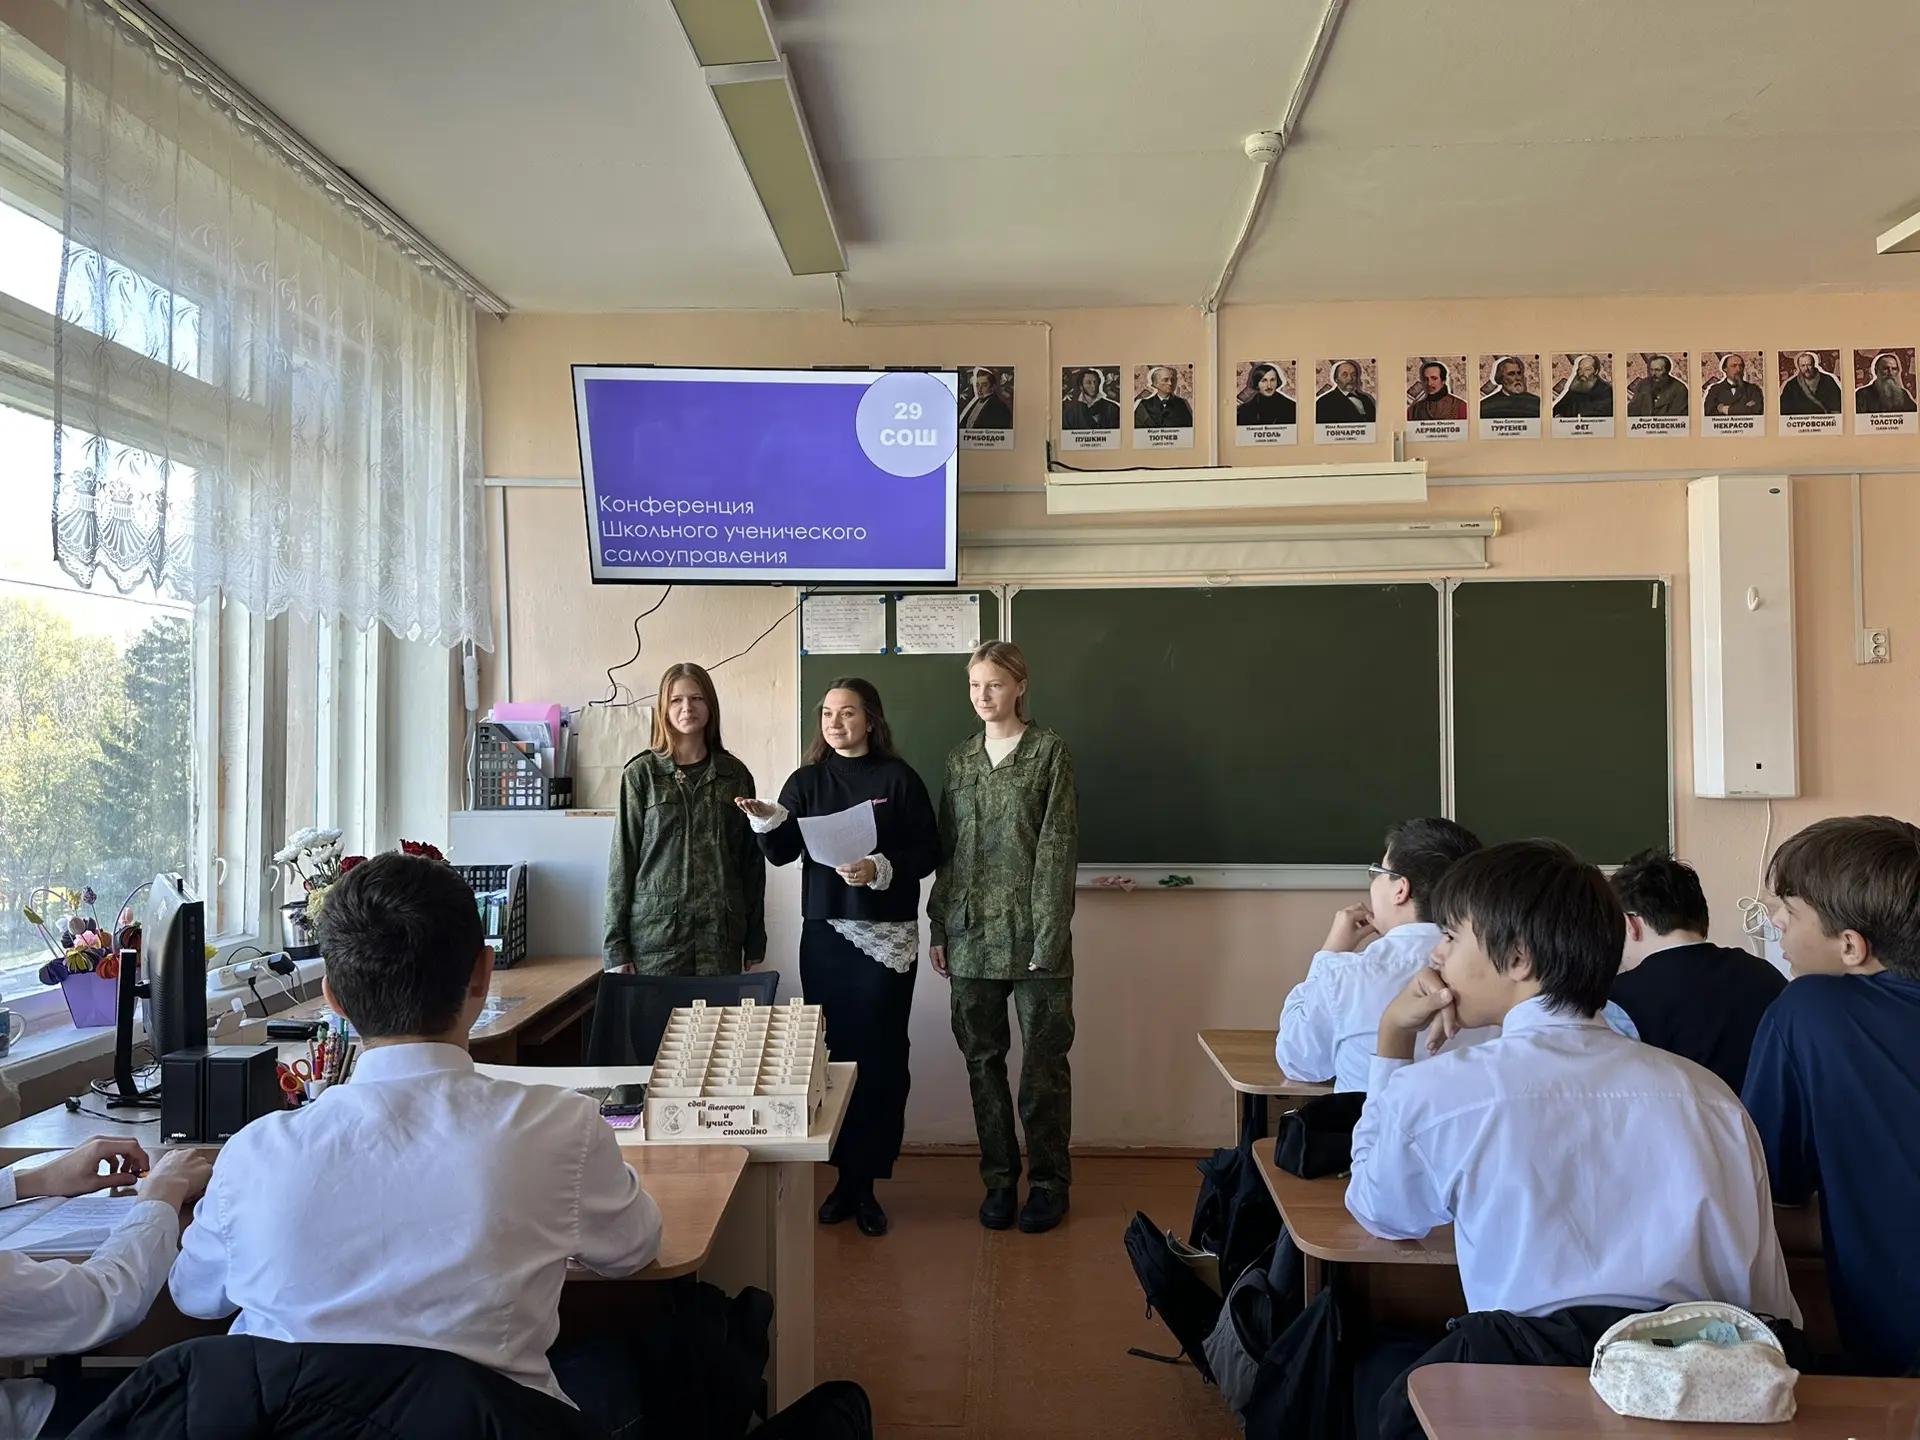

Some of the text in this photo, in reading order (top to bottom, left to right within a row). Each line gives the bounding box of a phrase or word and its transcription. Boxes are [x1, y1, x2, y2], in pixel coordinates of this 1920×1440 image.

[893, 402, 922, 420] 29
[1630, 421, 1687, 430] ДОСТОЕВСКИЙ
[1786, 419, 1837, 428] ОСТРОВСКИЙ
[1870, 417, 1904, 426] ТОЛСТОЙ
[879, 428, 938, 446] СОШ
[1148, 434, 1178, 442] ТЮТЧЕВ
[599, 495, 755, 517] Конференция
[602, 520, 867, 543] Школьного ученического
[604, 549, 788, 566] самоуправления
[688, 1100, 746, 1112] сдай телефон
[706, 1120, 734, 1128] учись
[723, 1127, 768, 1136] спокойно
